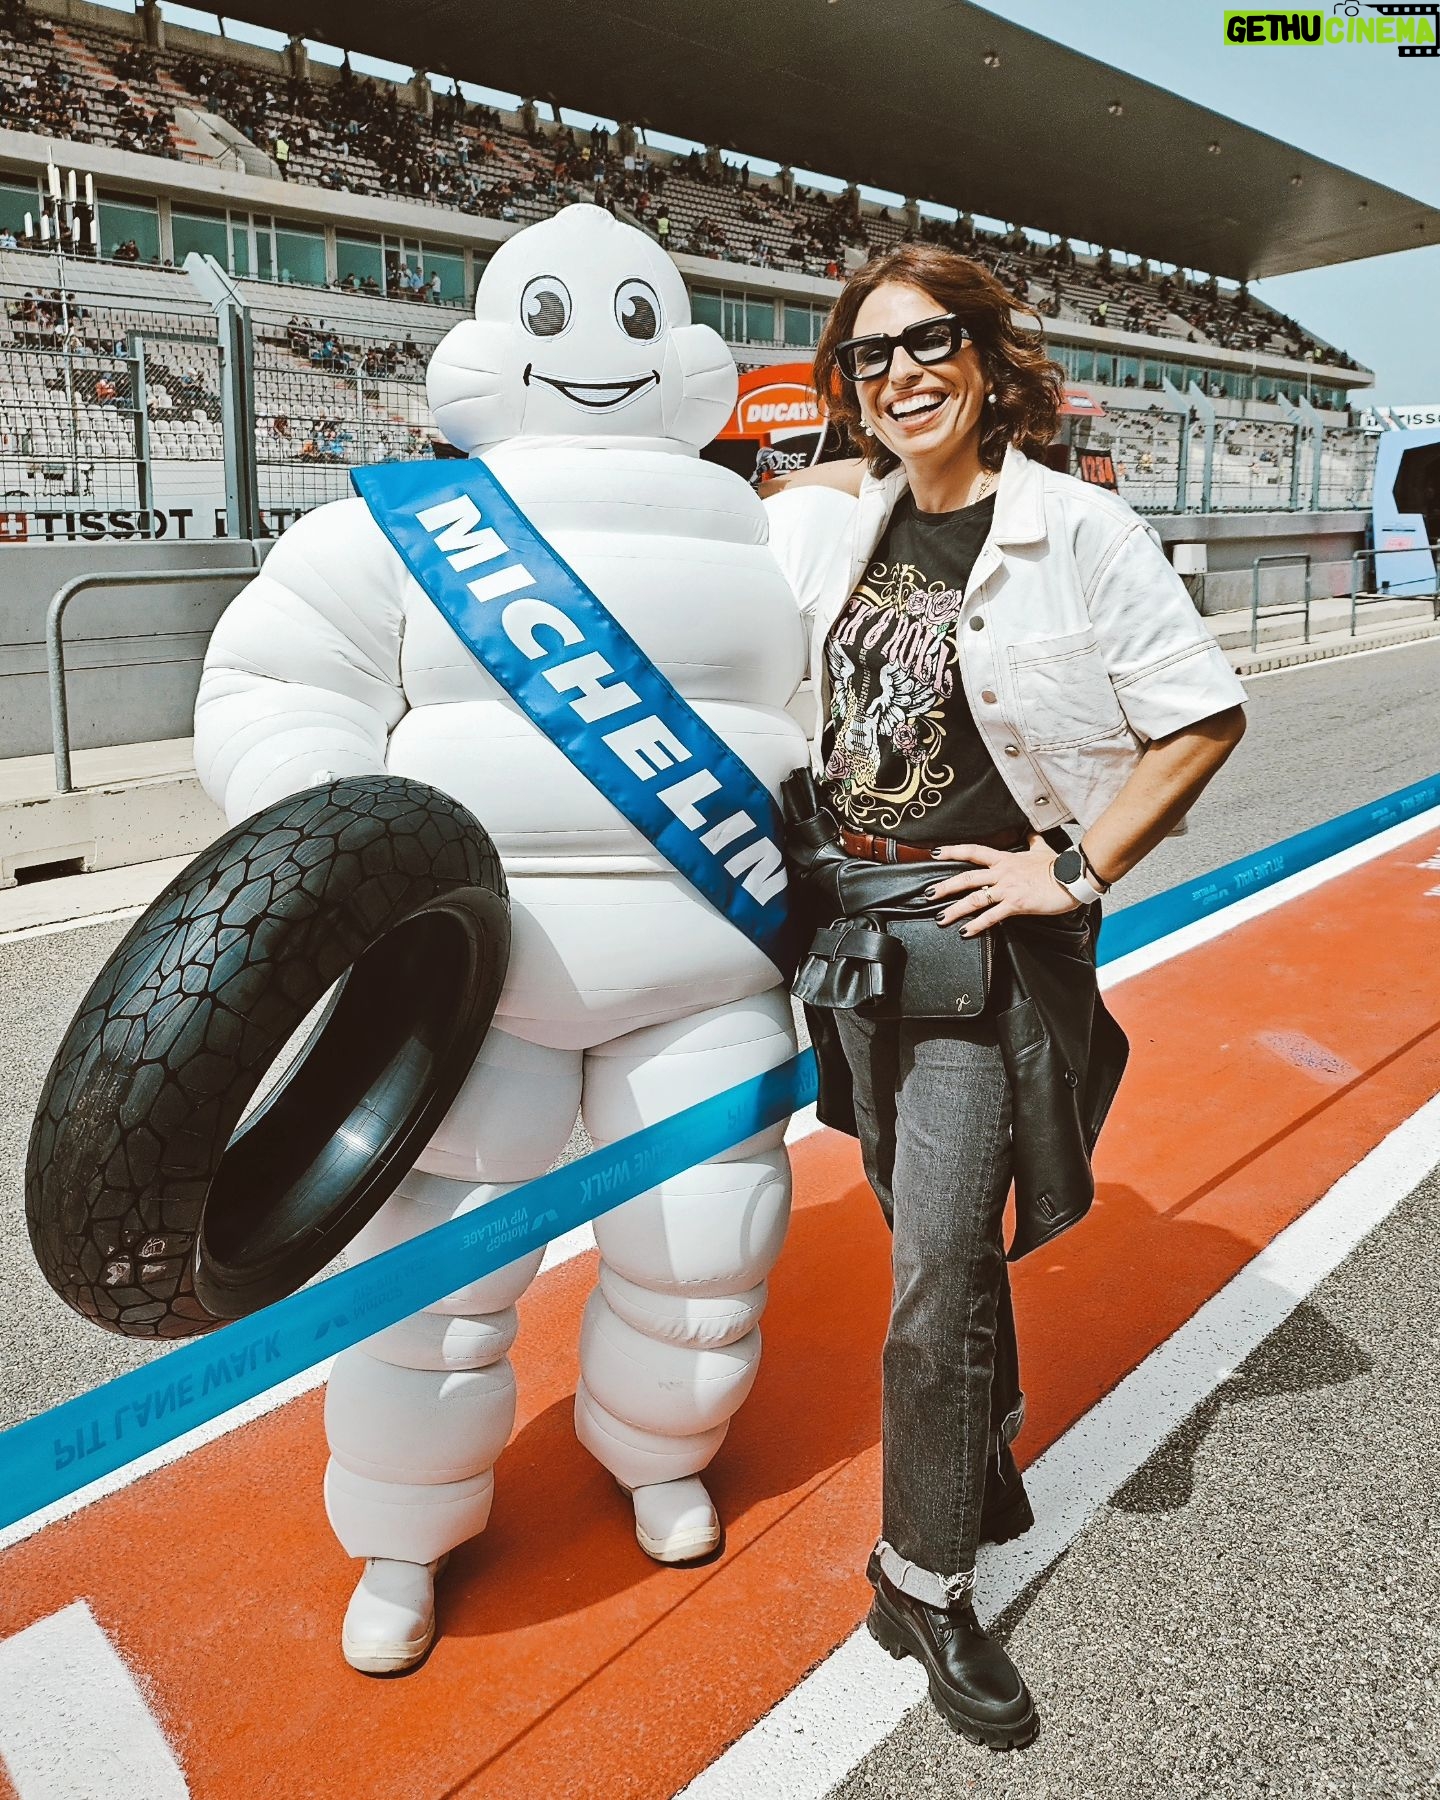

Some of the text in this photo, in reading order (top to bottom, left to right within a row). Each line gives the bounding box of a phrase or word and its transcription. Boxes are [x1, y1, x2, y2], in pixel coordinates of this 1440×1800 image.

[746, 402, 818, 423] DUCATI
[772, 452, 808, 470] ORSE
[880, 611, 954, 699] ROLL
[414, 493, 789, 907] MICHELIN
[579, 1159, 631, 1204] WALK
[462, 1206, 529, 1250] VIP VILLAGE
[485, 1220, 529, 1253] MotoGP
